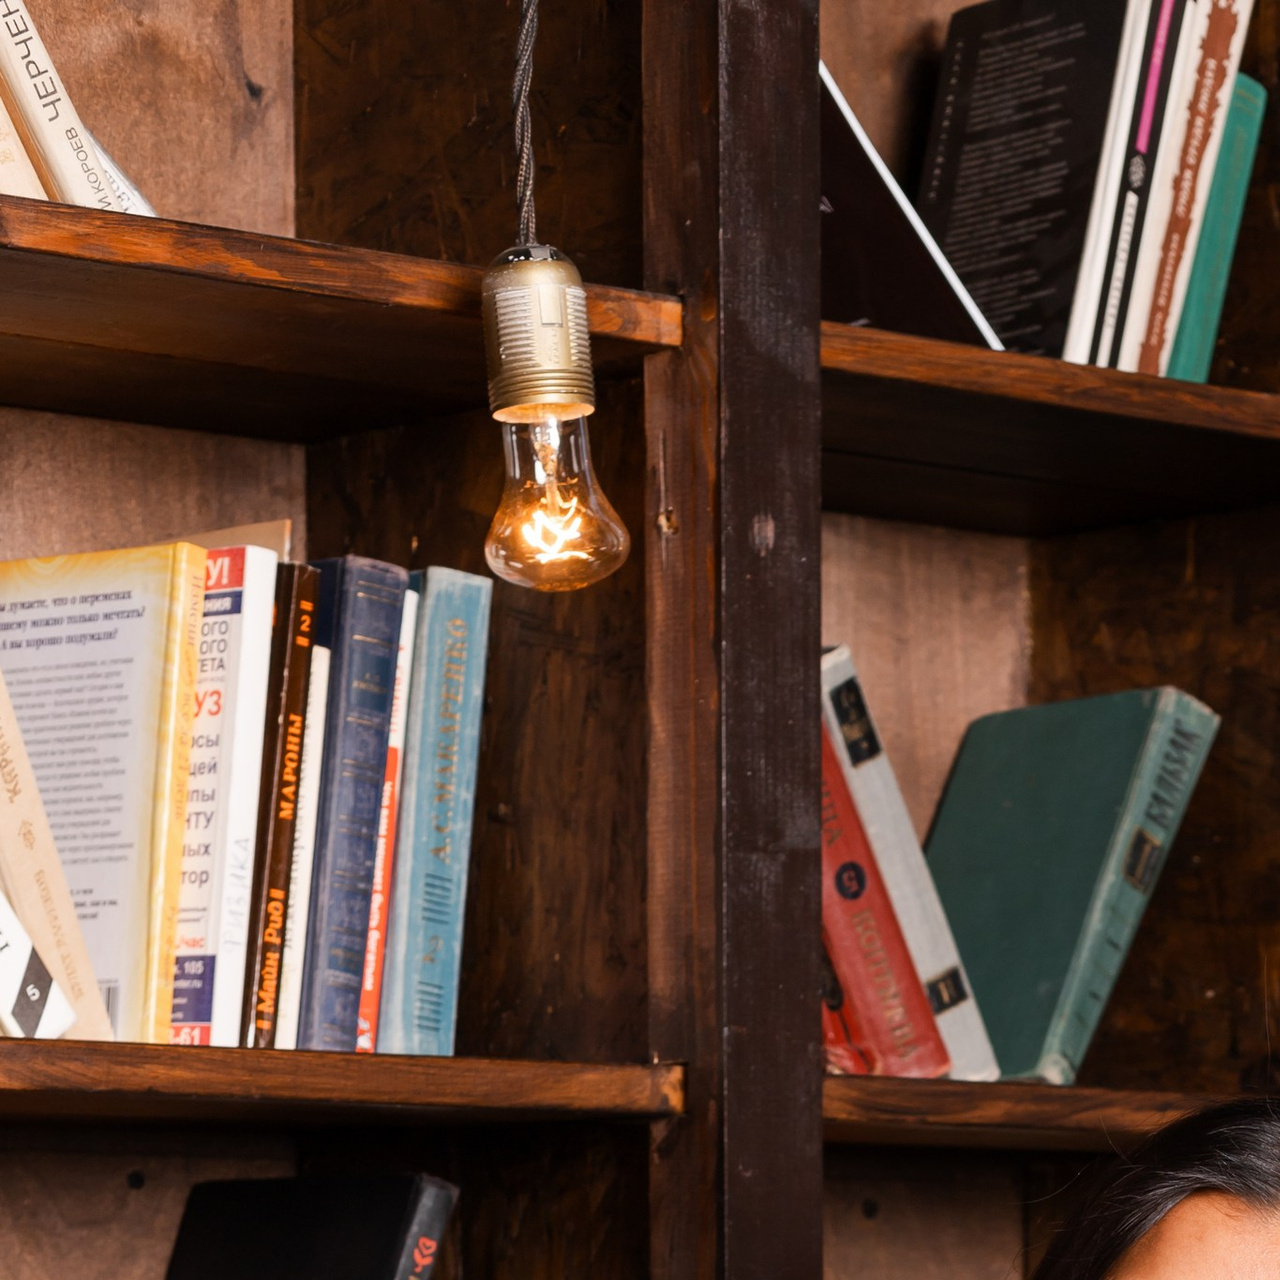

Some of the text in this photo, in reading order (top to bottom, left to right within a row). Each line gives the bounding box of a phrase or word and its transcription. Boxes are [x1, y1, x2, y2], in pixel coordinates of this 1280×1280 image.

[79, 590, 133, 606] переменах
[298, 615, 312, 634] 2
[278, 713, 305, 822] МАРОНЫ
[257, 900, 285, 1015] Майн Рид
[24, 983, 41, 1004] 5
